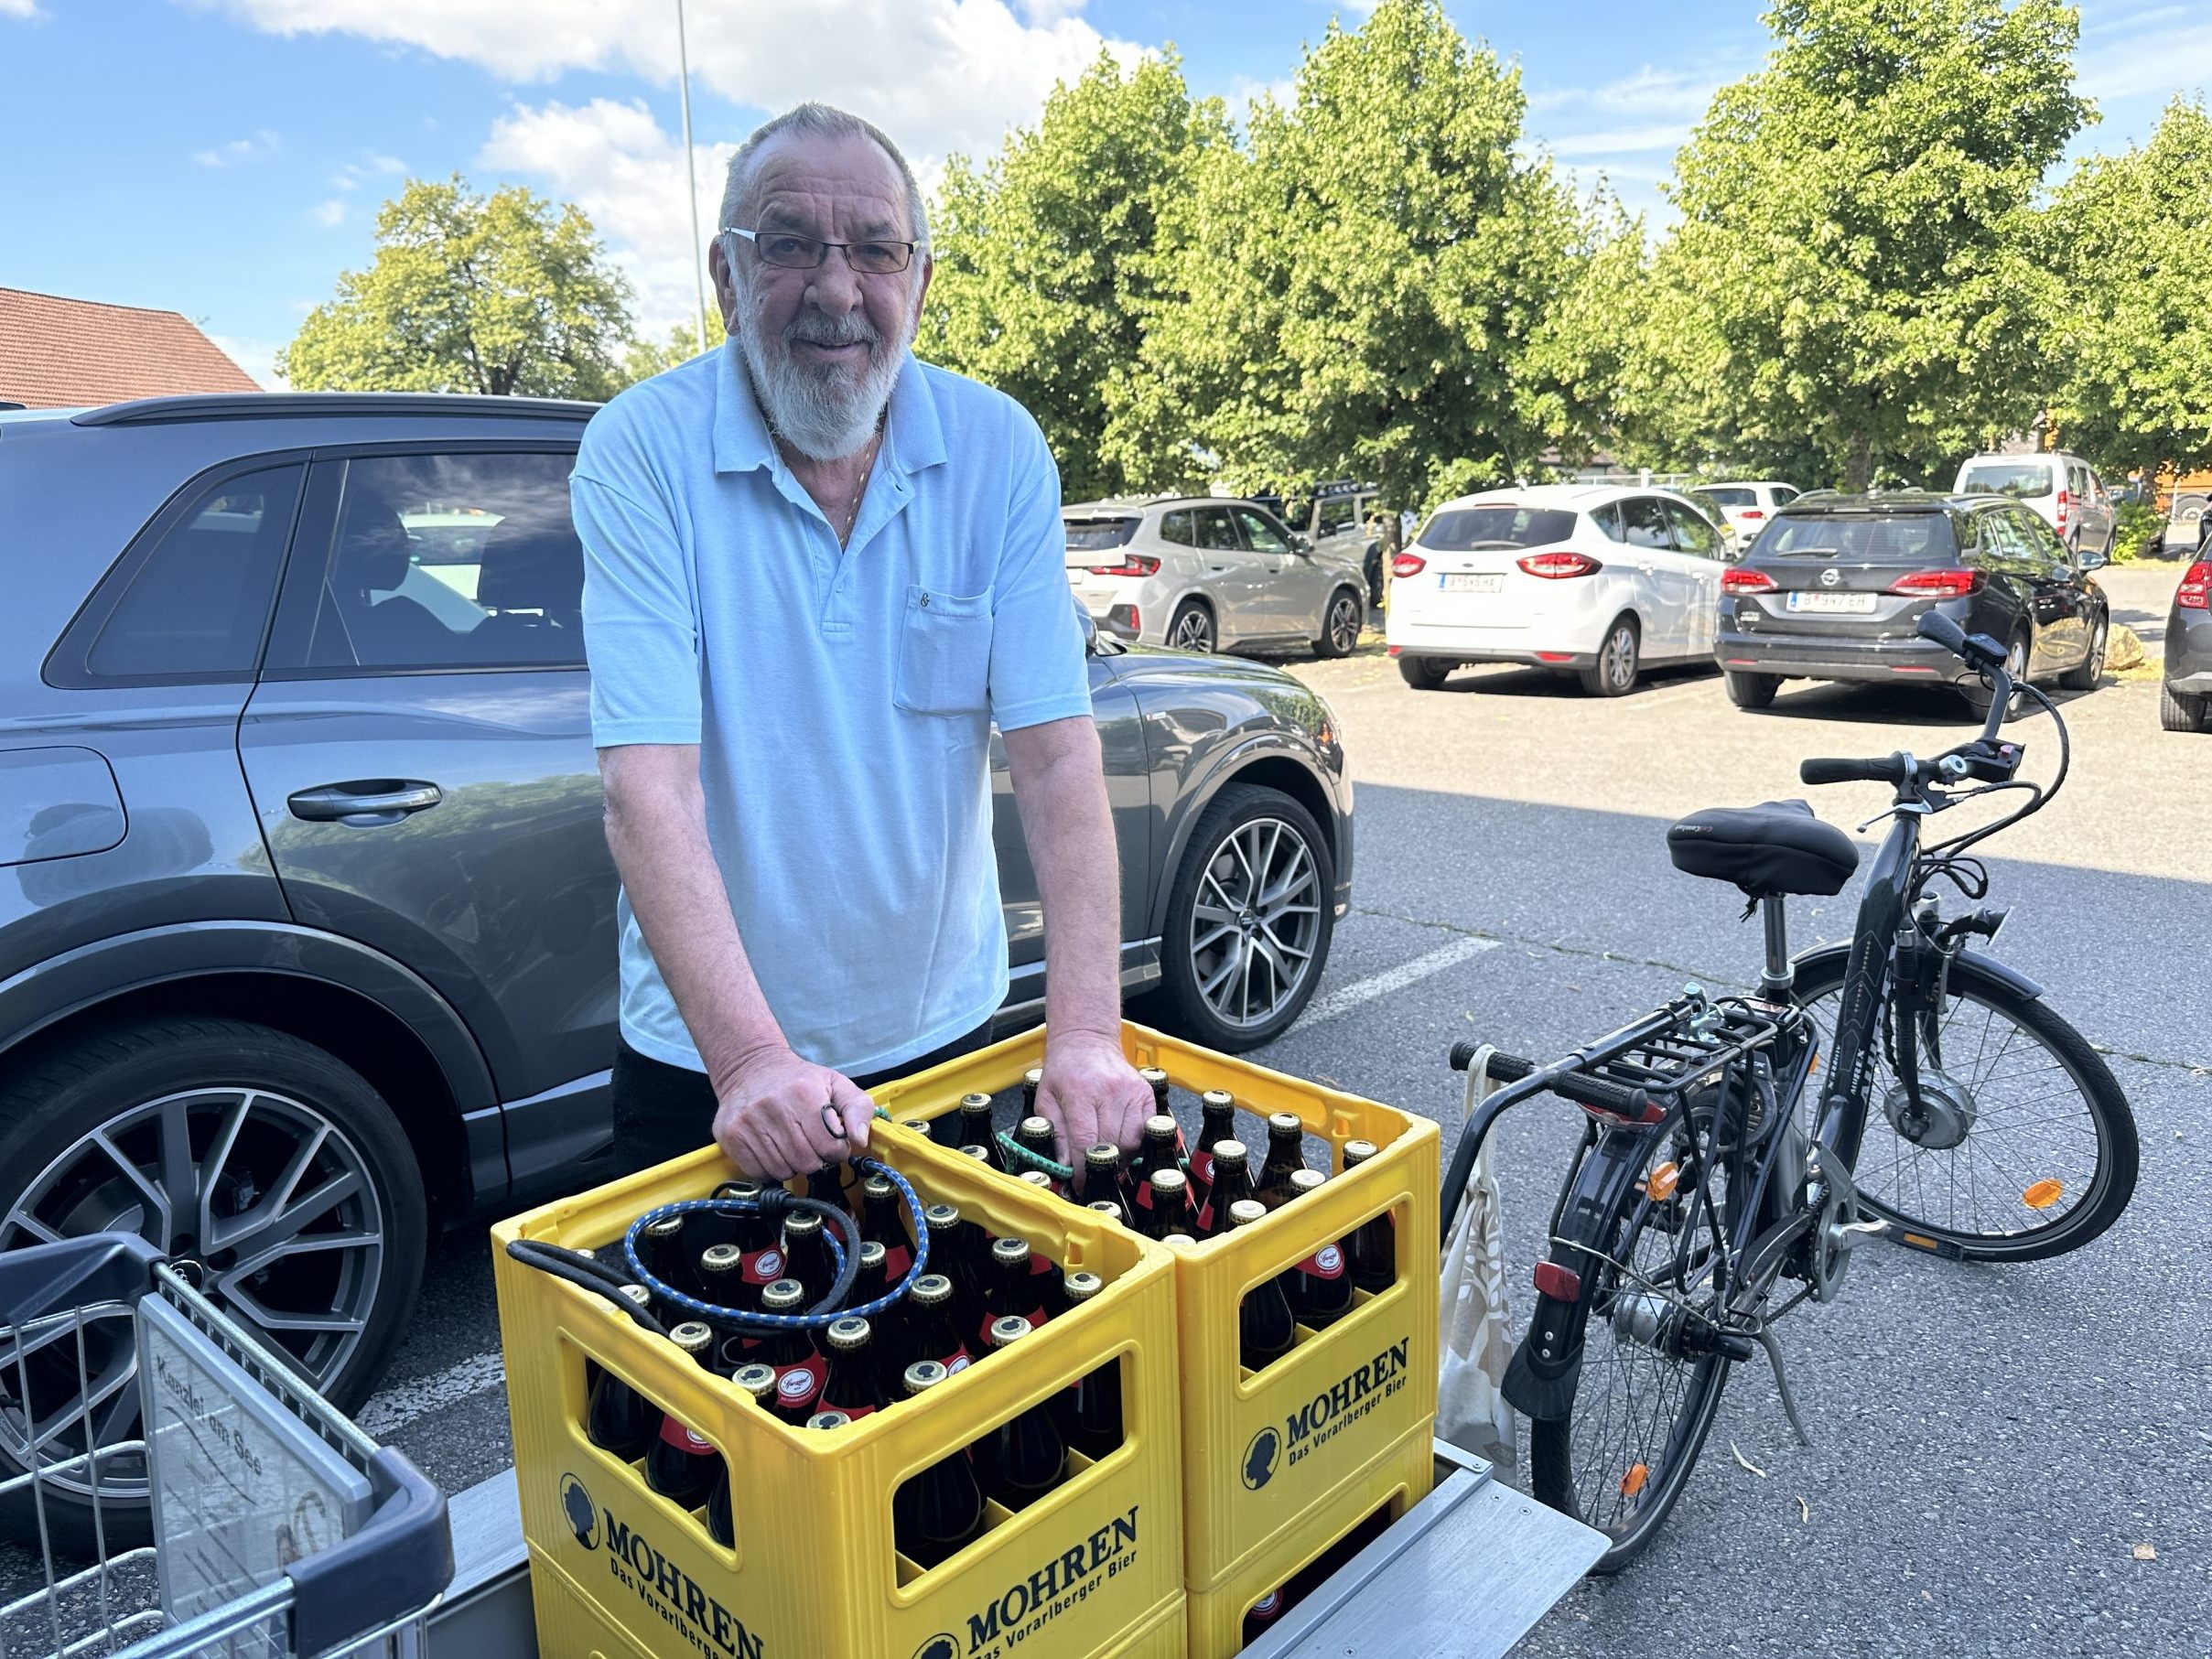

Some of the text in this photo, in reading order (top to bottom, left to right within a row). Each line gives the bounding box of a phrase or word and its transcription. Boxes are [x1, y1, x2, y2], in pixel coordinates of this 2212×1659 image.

[156, 1353, 206, 1424] Kanzlei
[208, 1414, 231, 1447] am
[232, 1428, 263, 1477] See
[1286, 1336, 1409, 1449] MOHREN
[1289, 1375, 1407, 1467] Das Vorarlberger Bier
[603, 1507, 764, 1659] MOHREN
[610, 1557, 633, 1589] Das
[966, 1505, 1139, 1655] MOHREN
[1005, 1574, 1103, 1649] Vorarlberger
[1108, 1550, 1137, 1578] Bier
